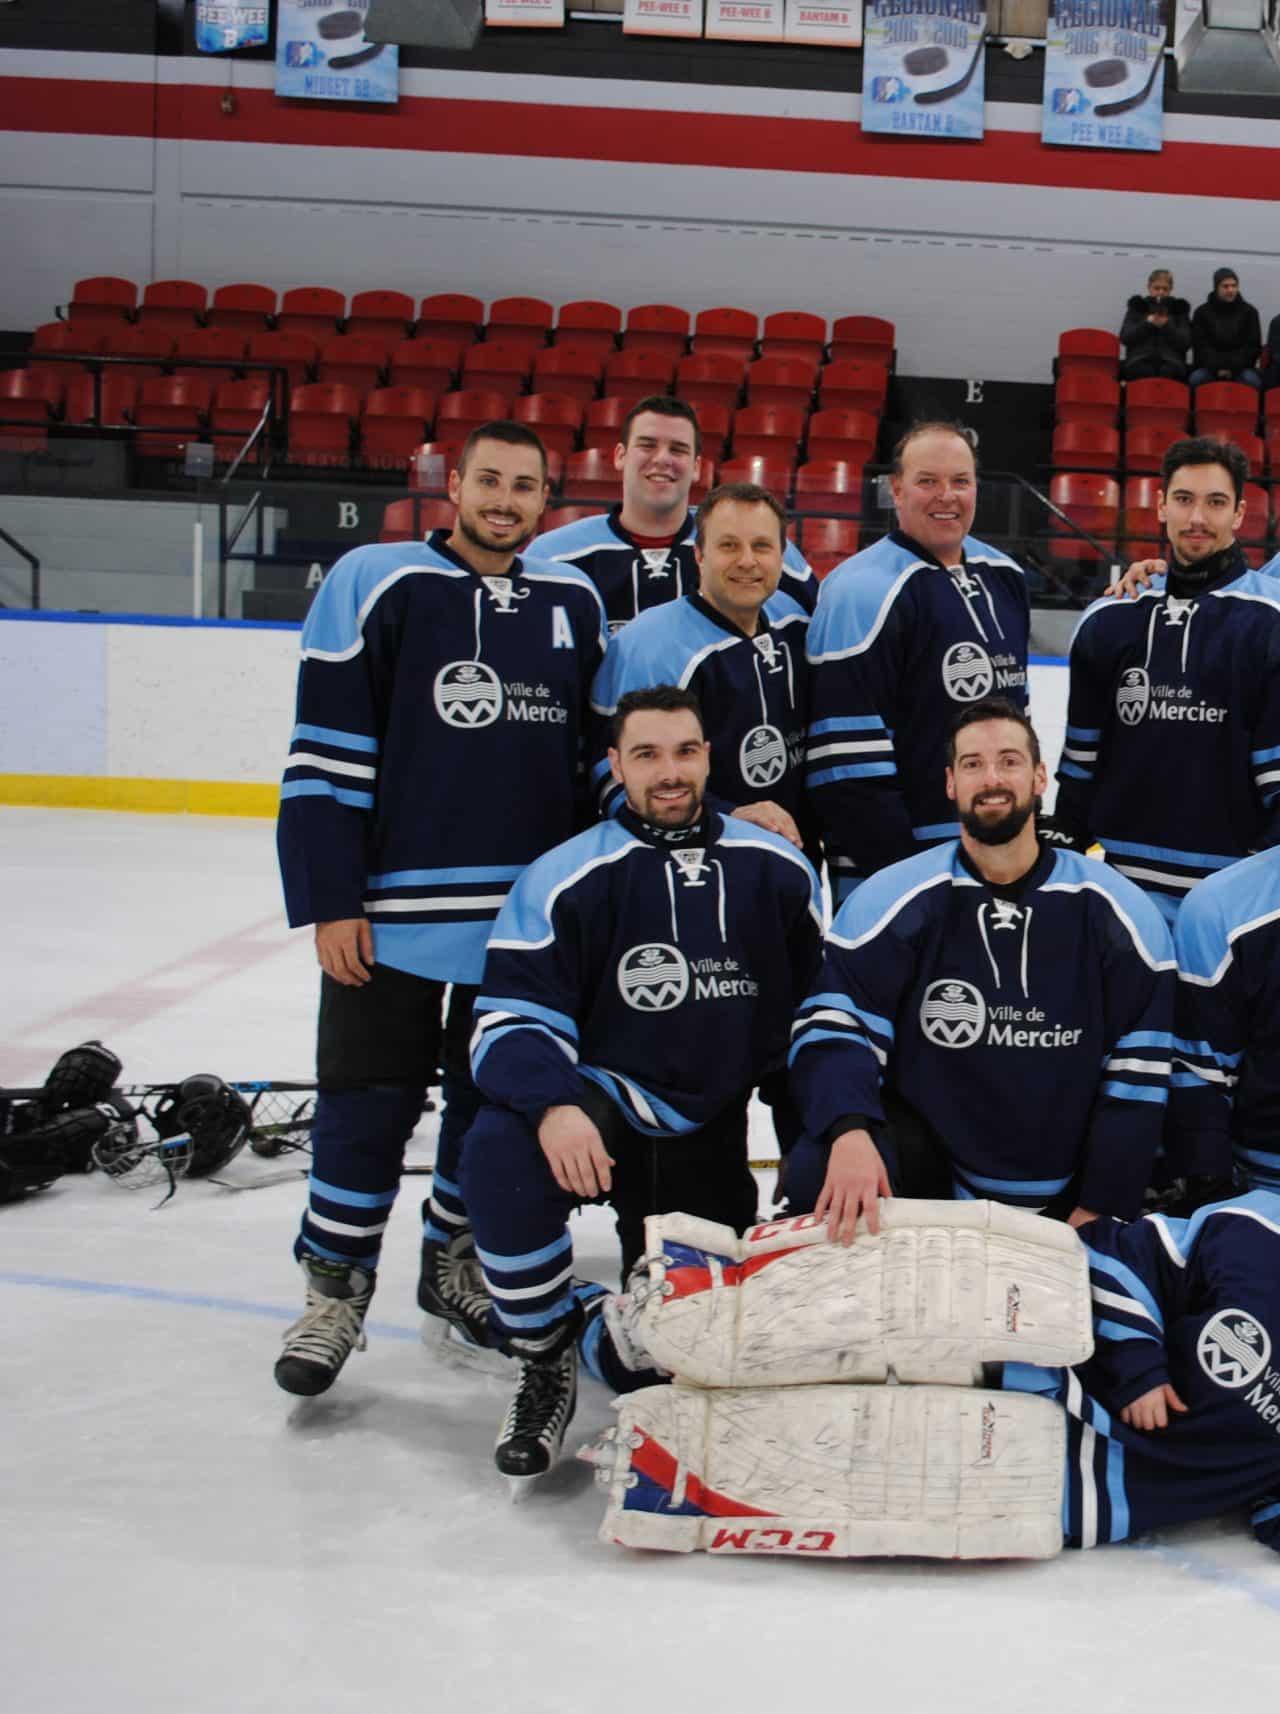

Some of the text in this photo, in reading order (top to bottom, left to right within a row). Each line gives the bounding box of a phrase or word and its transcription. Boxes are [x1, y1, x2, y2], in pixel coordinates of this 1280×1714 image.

[965, 380, 984, 403] E
[338, 502, 360, 529] B
[552, 605, 575, 649] A
[503, 682, 551, 698] Ville de
[1150, 685, 1193, 699] Ville de
[1149, 700, 1229, 723] Mercier
[690, 957, 740, 975] Ville de
[987, 1006, 1046, 1022] Ville de
[987, 1024, 1083, 1048] Mercier
[711, 1527, 837, 1552] CCM
